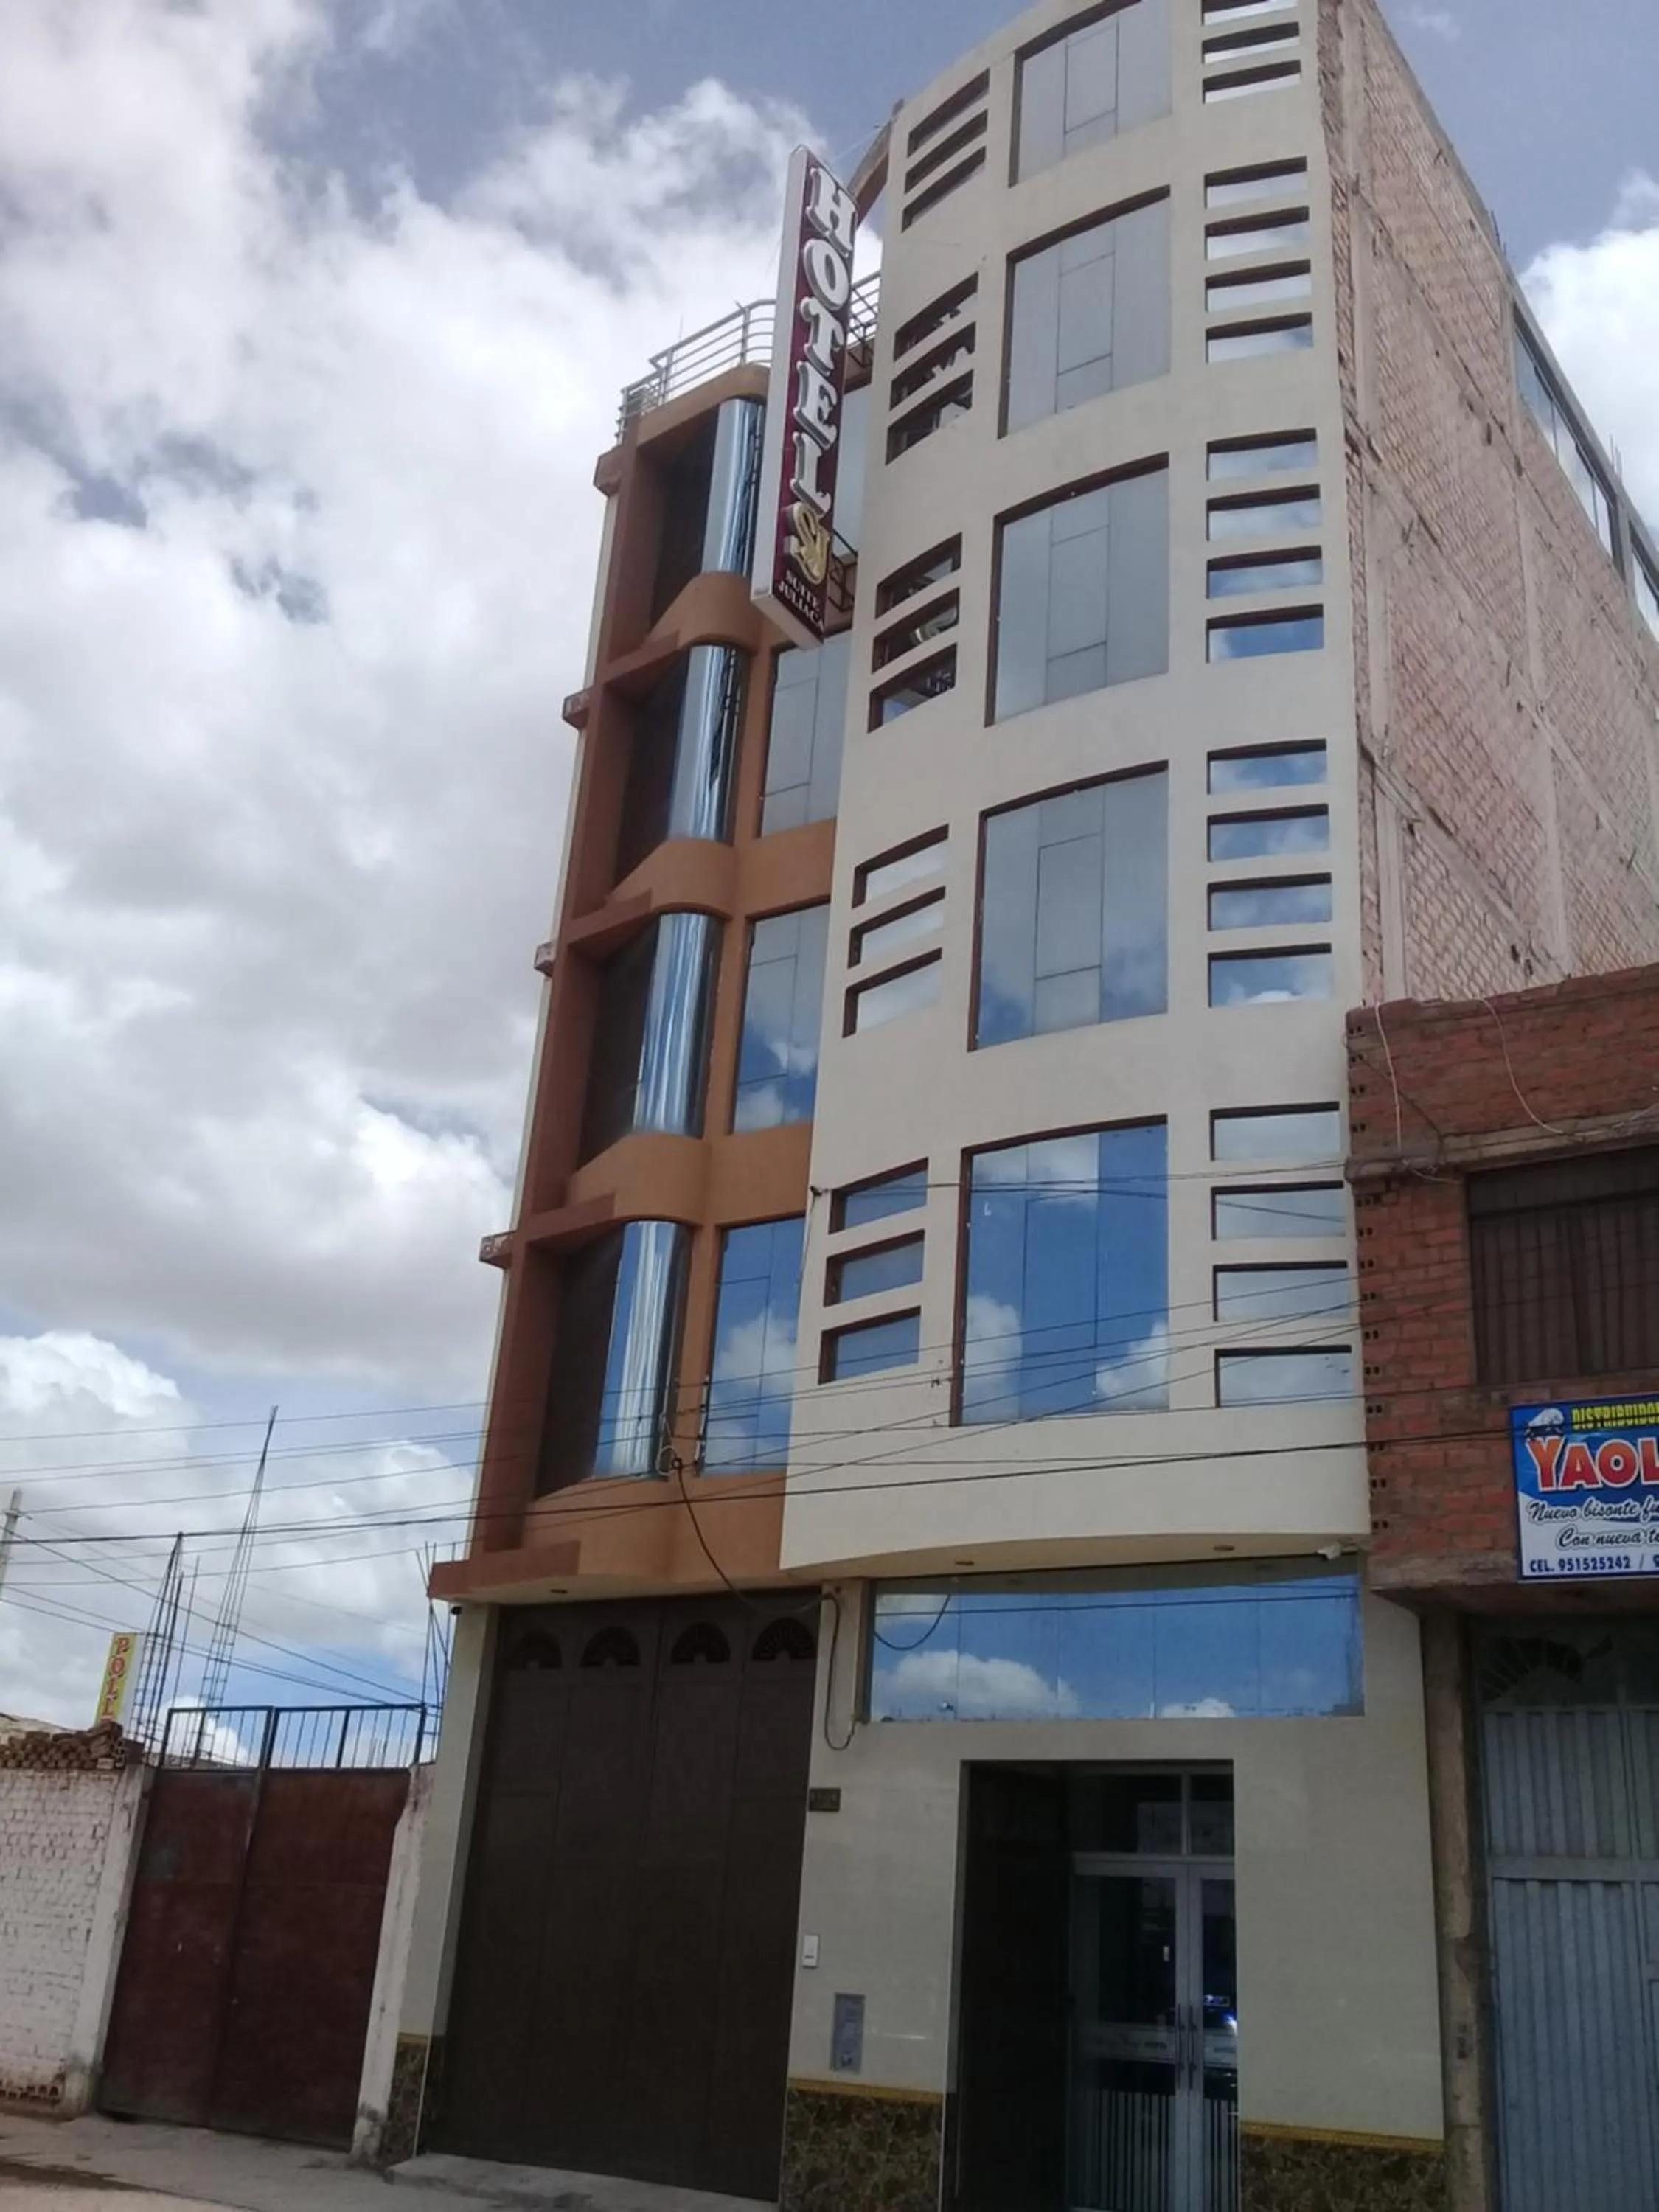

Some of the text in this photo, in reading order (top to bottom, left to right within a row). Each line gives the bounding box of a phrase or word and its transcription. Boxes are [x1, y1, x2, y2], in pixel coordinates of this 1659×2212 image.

[790, 167, 858, 518] HOTEL
[1529, 1501, 1578, 1521] Nuevo
[1585, 1498, 1635, 1519] bisonte
[1559, 1527, 1590, 1547] Con
[1596, 1531, 1641, 1545] nueva
[1529, 1559, 1555, 1573] CEL.
[101, 1637, 130, 1722] POLL
